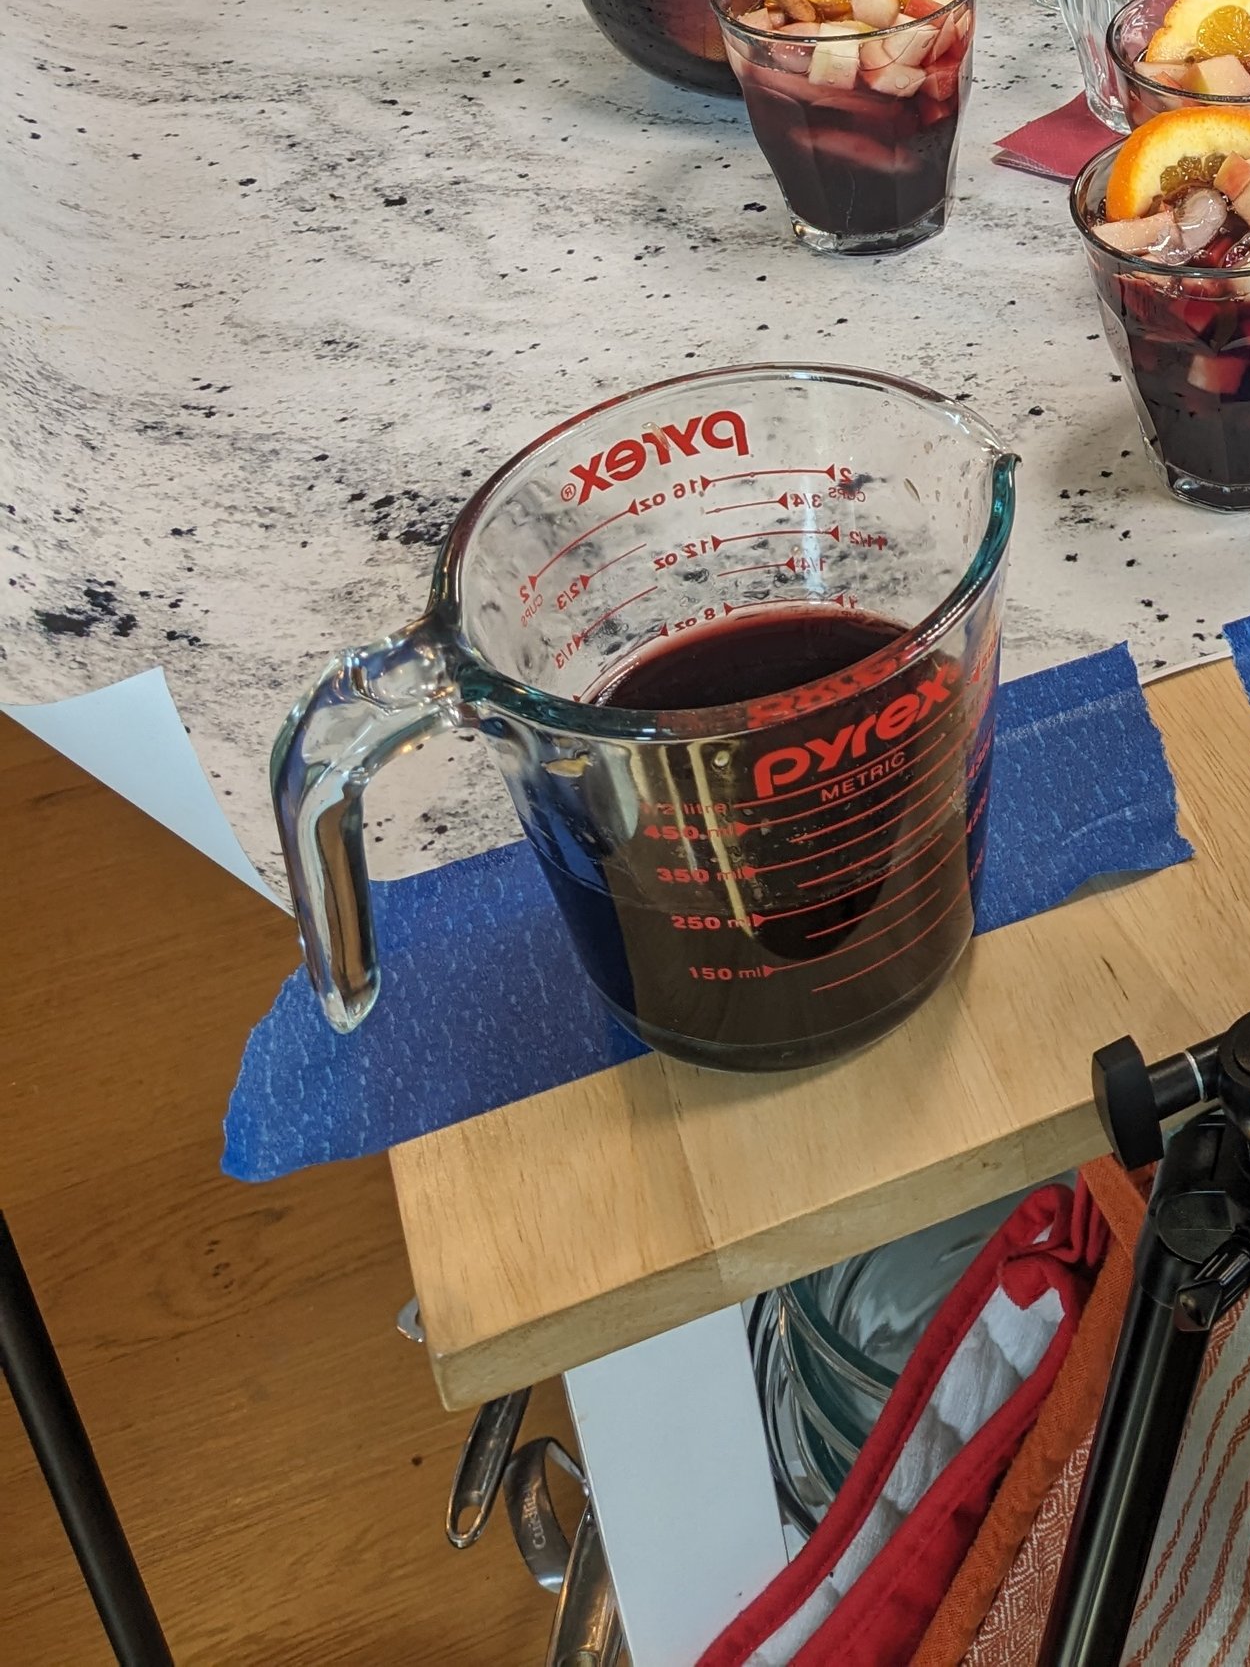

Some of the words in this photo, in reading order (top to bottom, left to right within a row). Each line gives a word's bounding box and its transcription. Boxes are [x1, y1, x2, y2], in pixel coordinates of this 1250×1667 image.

[821, 751, 906, 803] METRIC
[656, 867, 710, 883] 350
[671, 915, 722, 930] 250
[688, 966, 733, 981] 150
[739, 967, 761, 979] ml
